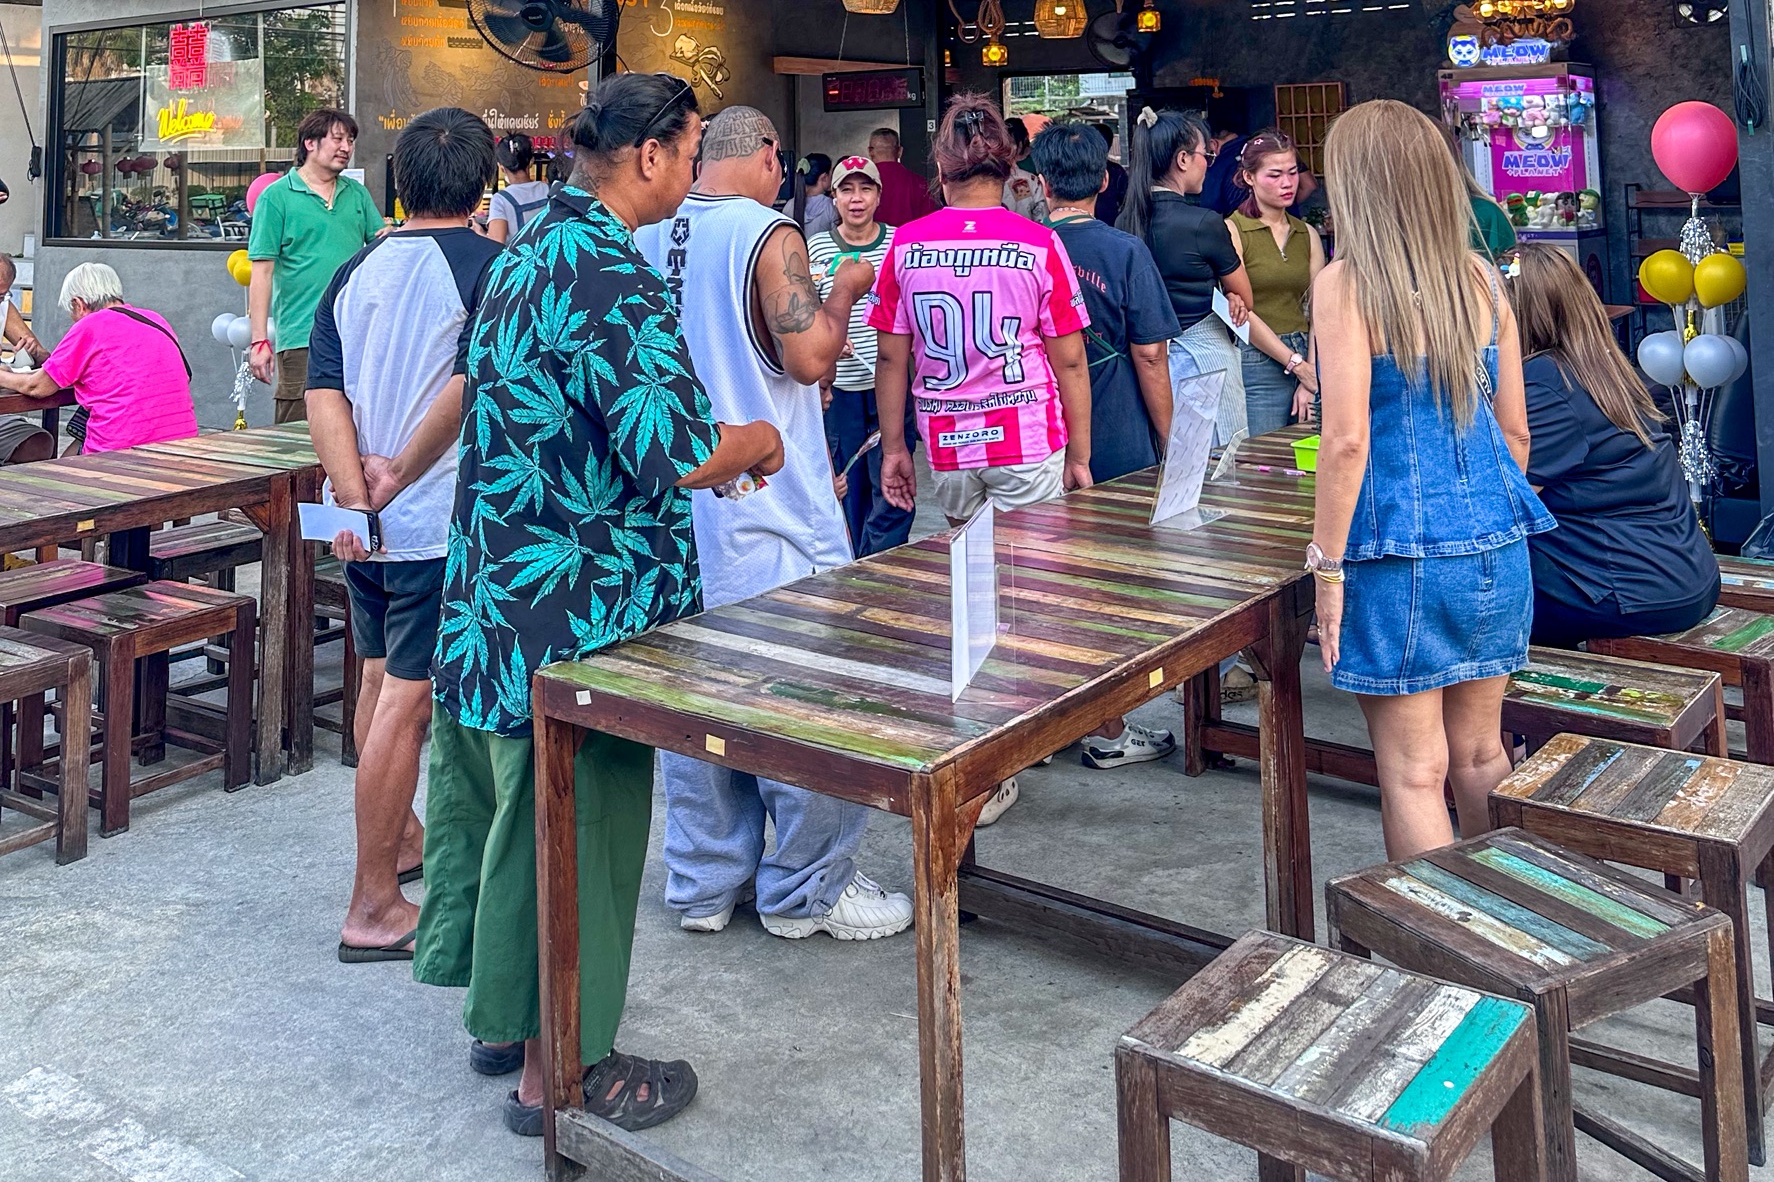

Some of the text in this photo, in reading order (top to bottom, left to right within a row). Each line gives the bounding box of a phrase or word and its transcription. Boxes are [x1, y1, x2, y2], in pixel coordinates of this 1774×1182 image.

[1482, 43, 1548, 59] MEOW
[907, 91, 917, 101] kg
[157, 97, 215, 140] Welcome
[842, 155, 869, 171] W
[1503, 153, 1570, 169] MEOW
[1513, 168, 1559, 177] PLANET
[905, 243, 1036, 277] น้องภูเหนือ
[913, 290, 1025, 391] 94
[942, 429, 999, 441] ZENZORO
